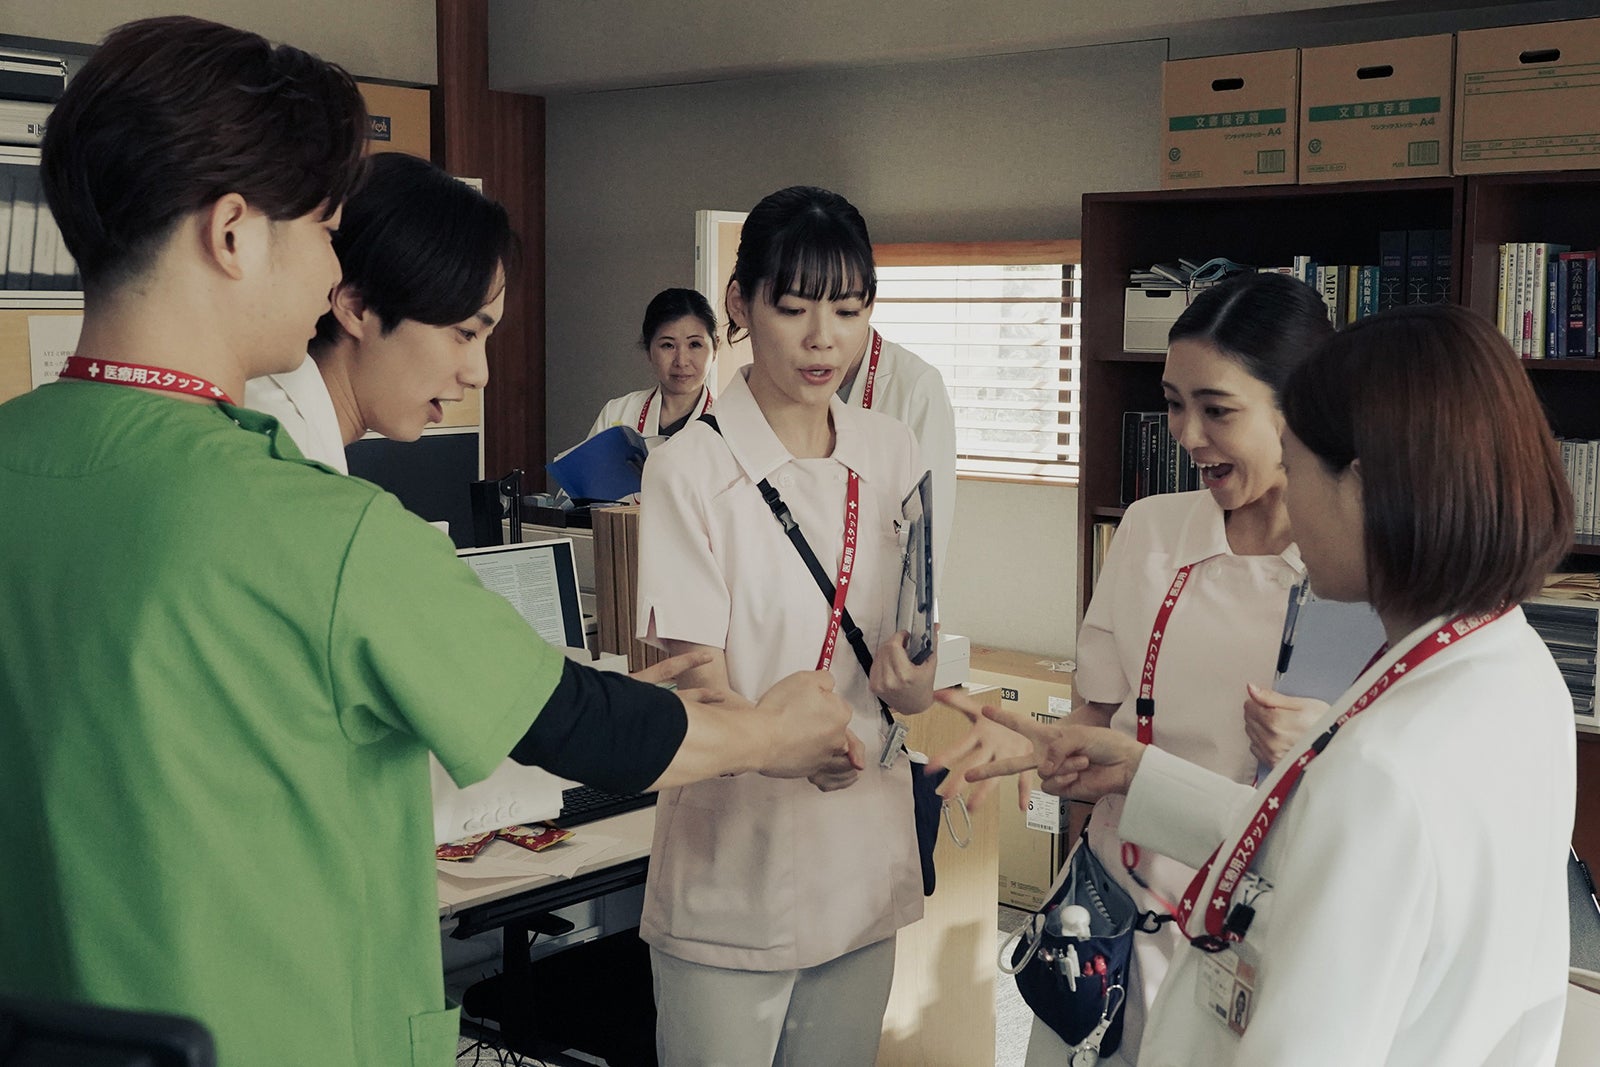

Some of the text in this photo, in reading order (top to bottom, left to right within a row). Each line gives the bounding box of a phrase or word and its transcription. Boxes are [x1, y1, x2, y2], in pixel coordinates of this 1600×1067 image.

[1195, 112, 1259, 128] 文書保存箱
[1339, 101, 1411, 118] 文書保存箱
[1420, 117, 1435, 127] A4
[1268, 128, 1282, 137] A4
[1326, 274, 1336, 300] MRI
[1571, 261, 1583, 312] 医学英和大辞典
[104, 364, 205, 392] 医療用スタッフ
[842, 511, 857, 574] 医療用スタッフ
[1218, 812, 1269, 893] 医療用スタッフ
